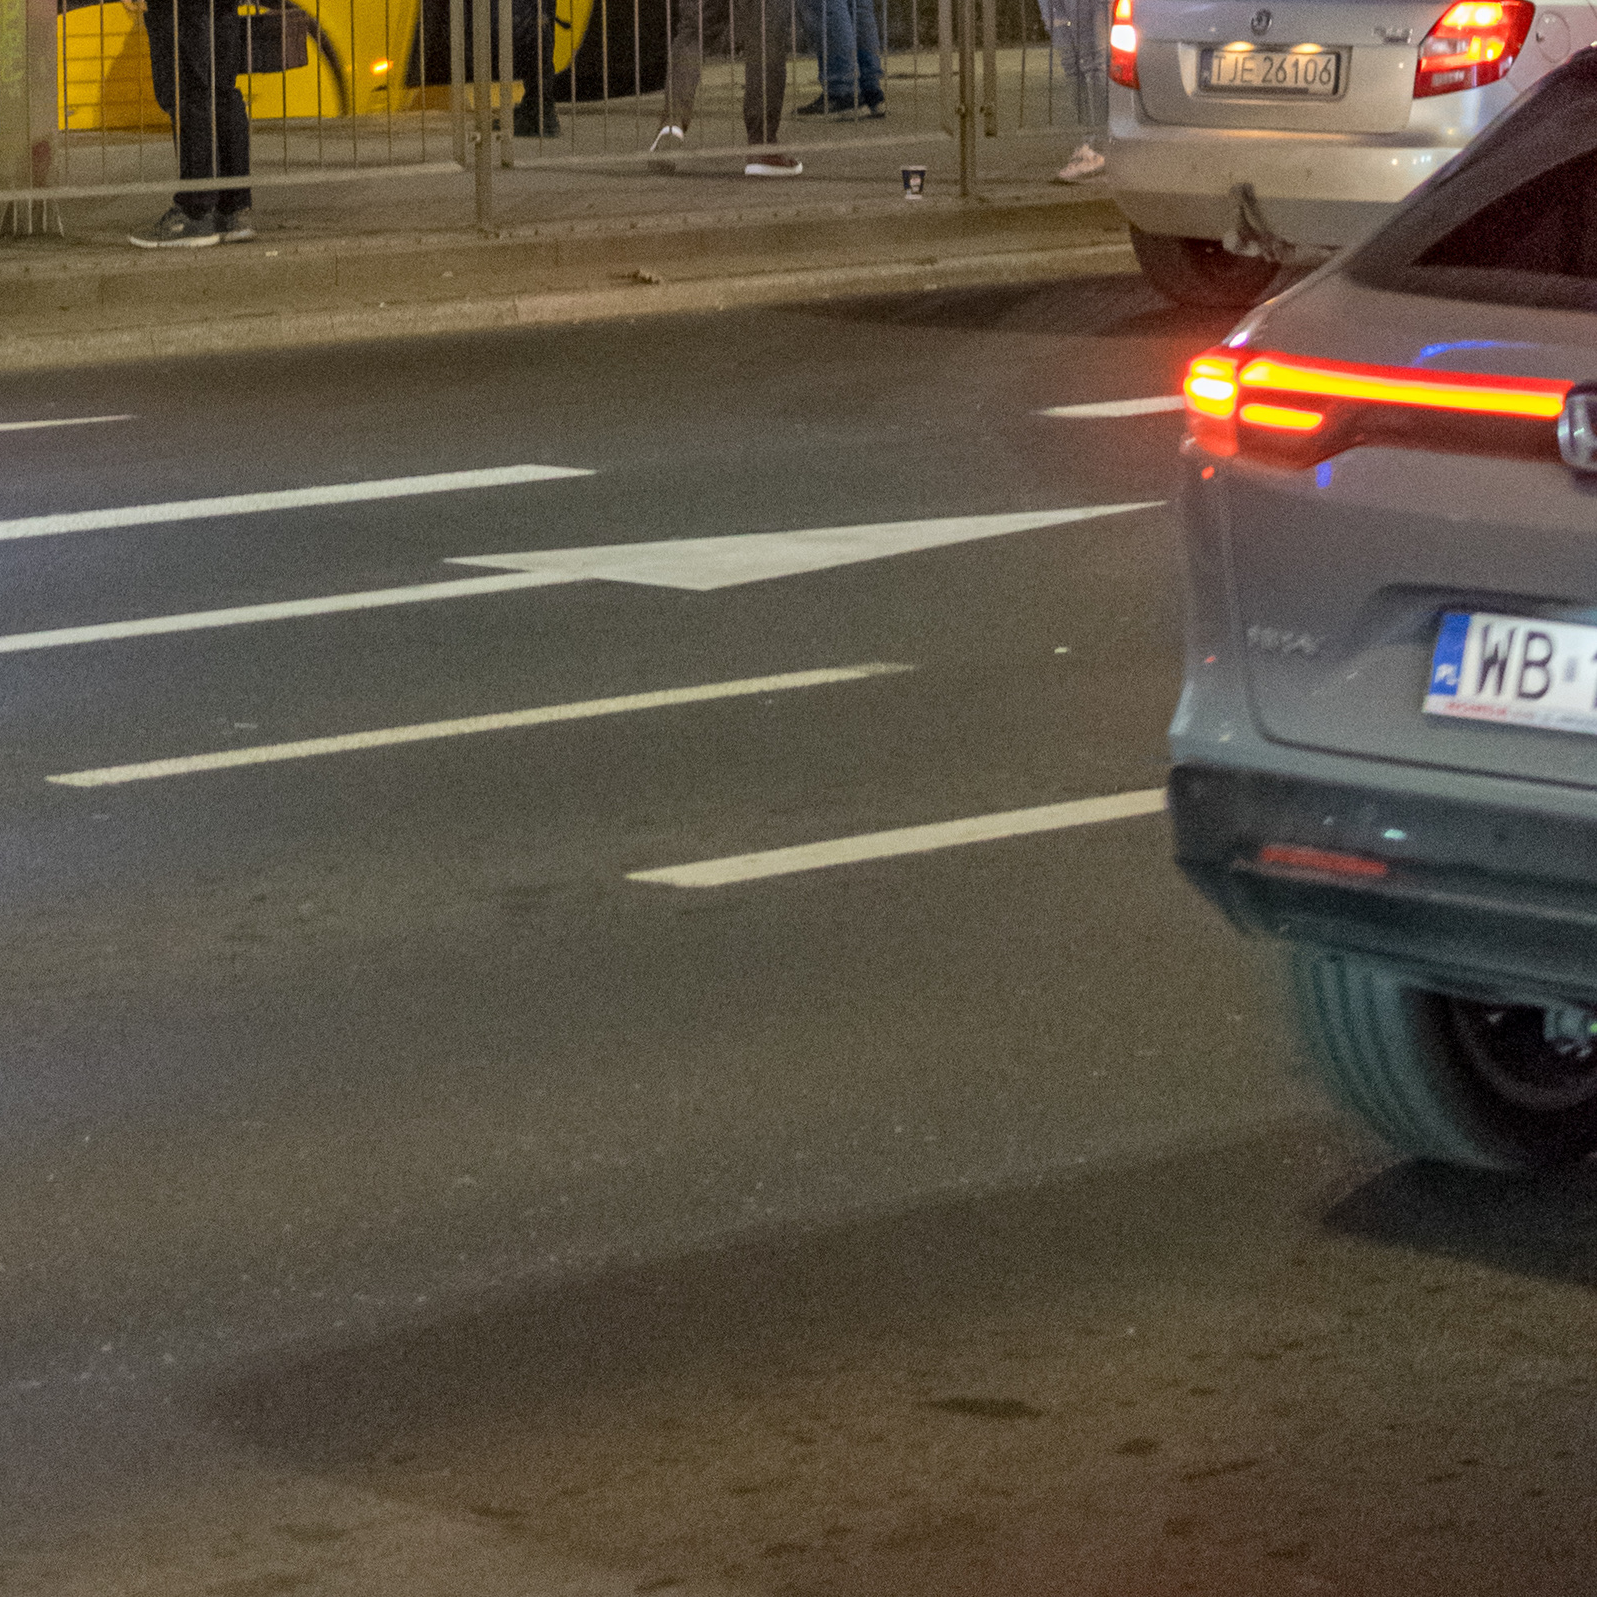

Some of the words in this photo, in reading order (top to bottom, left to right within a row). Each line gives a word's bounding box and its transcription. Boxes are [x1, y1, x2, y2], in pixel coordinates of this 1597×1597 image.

[1214, 54, 1255, 84] TJE
[1261, 54, 1333, 85] 26106
[1475, 621, 1554, 701] WB
